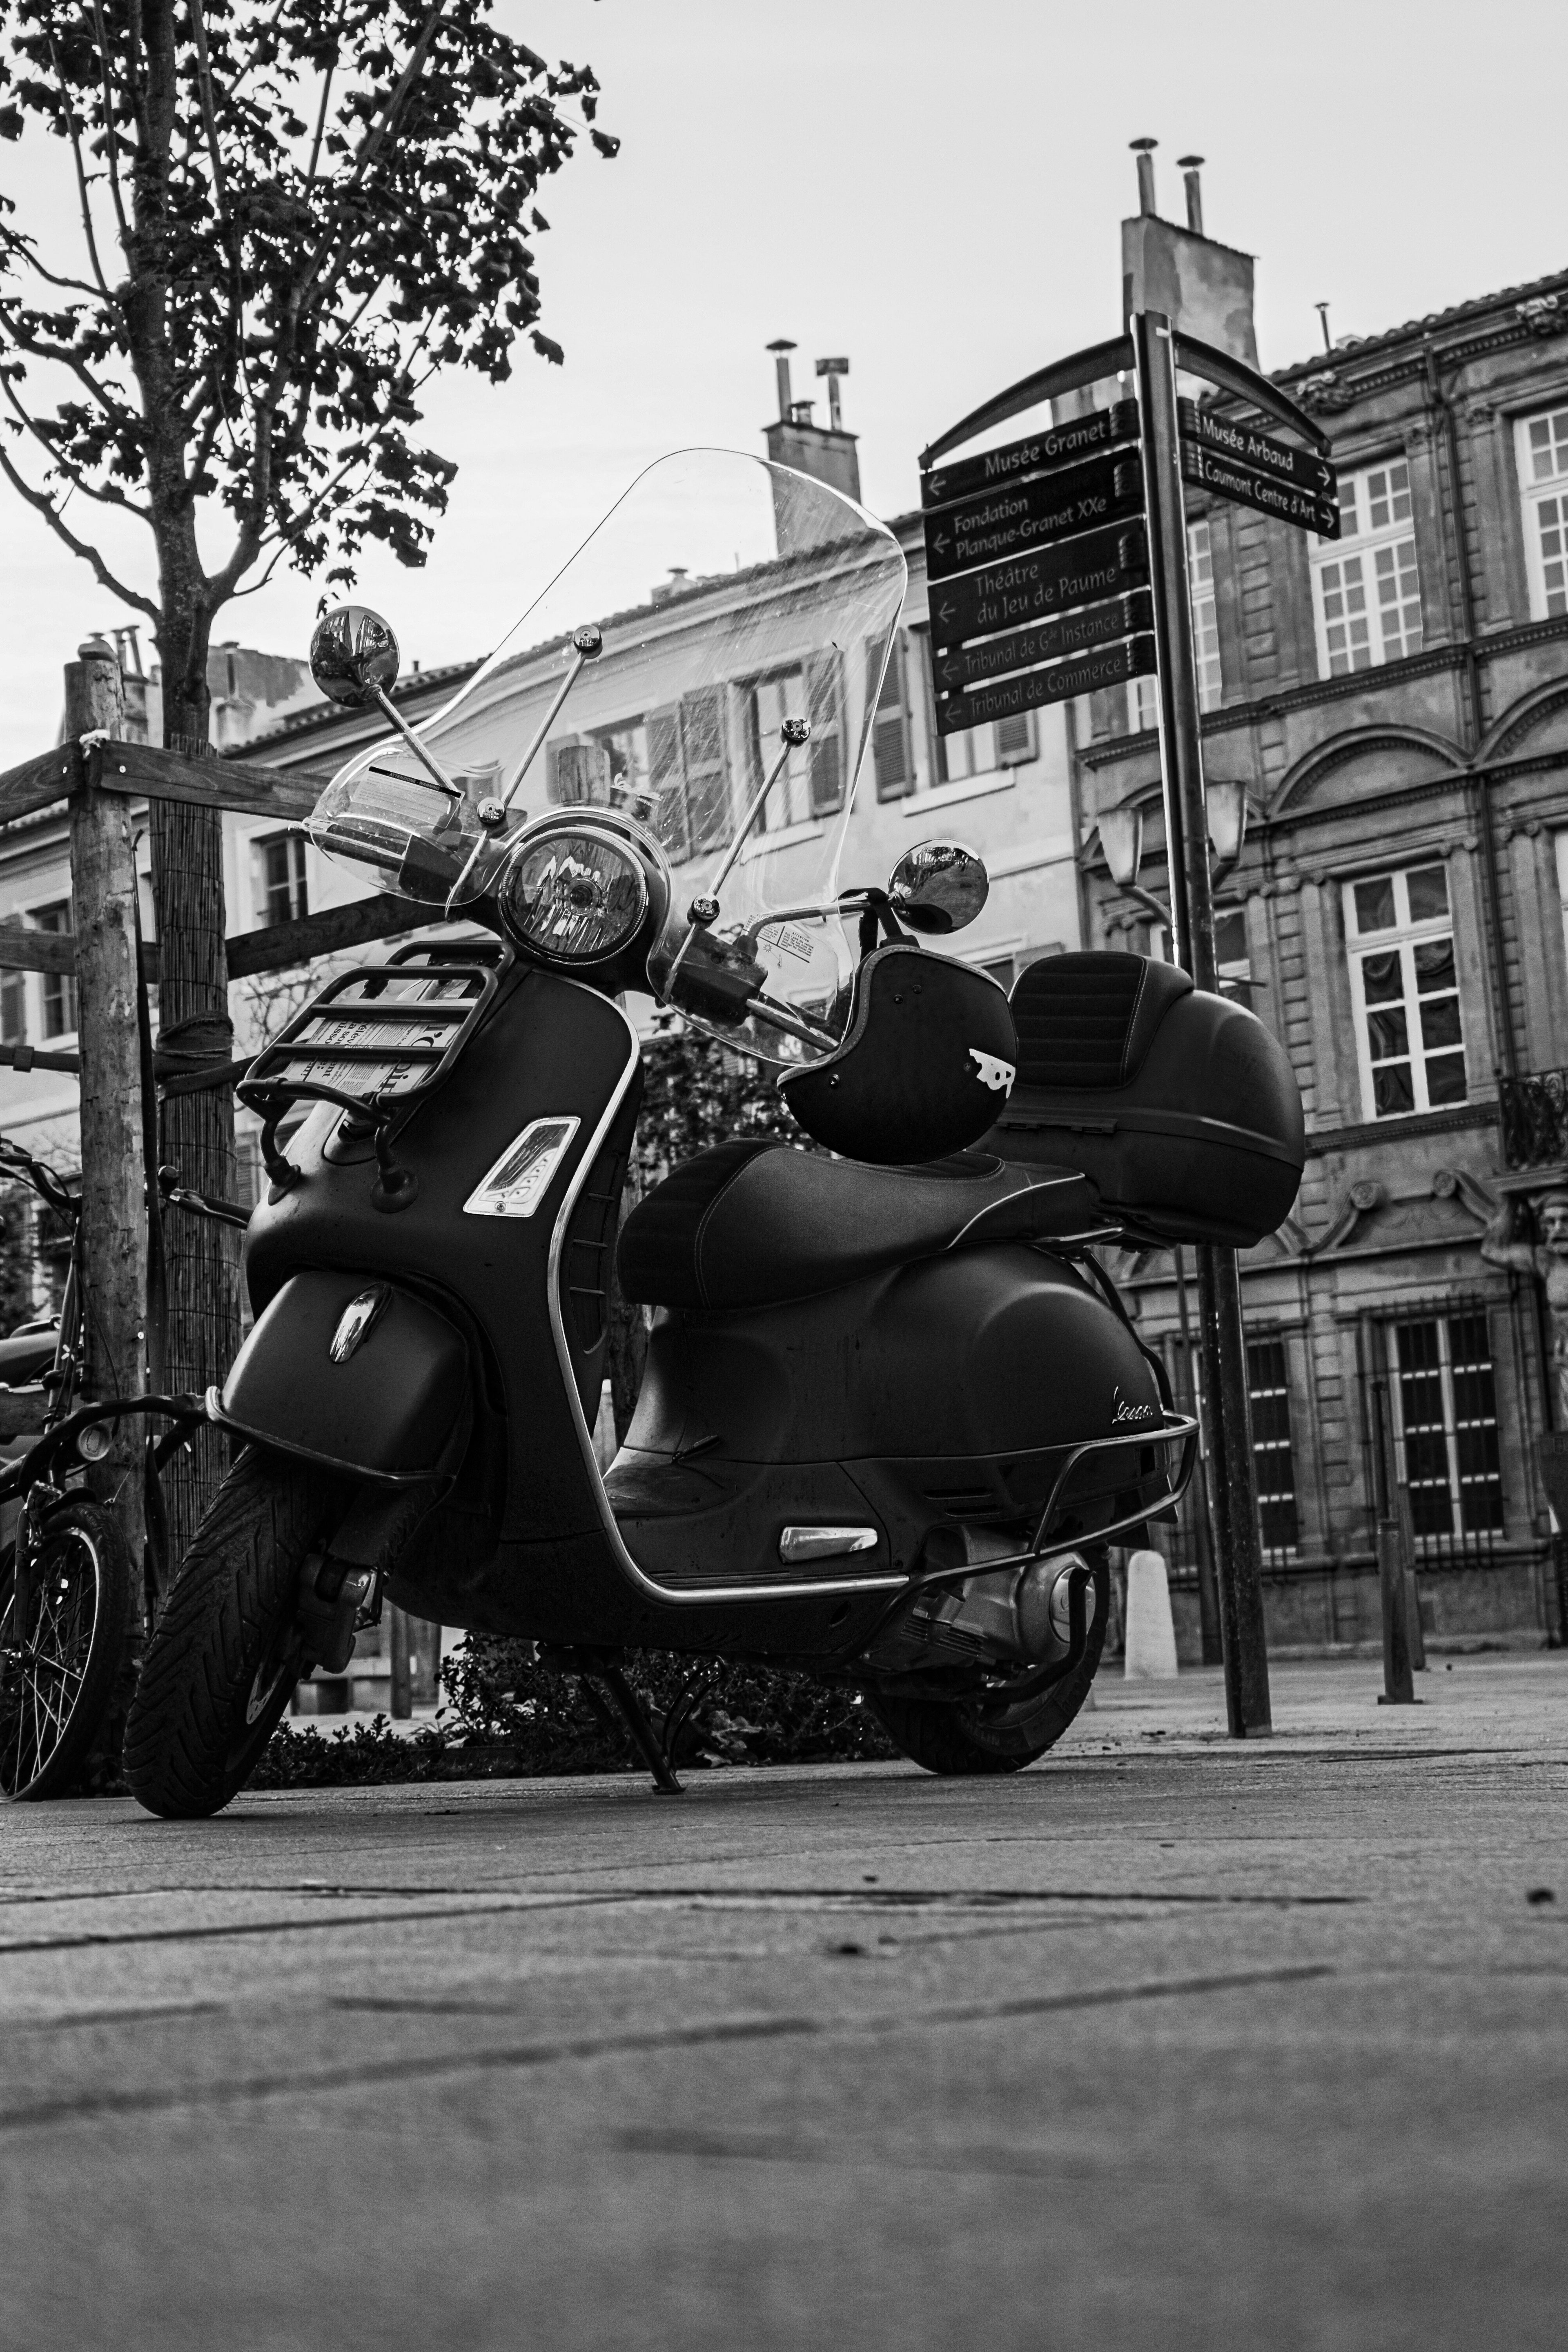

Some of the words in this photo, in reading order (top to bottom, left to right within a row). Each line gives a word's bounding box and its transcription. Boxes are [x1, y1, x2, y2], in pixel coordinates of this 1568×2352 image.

[984, 443, 1040, 477] Musée
[1045, 421, 1105, 456] Granet
[1203, 416, 1244, 451] Musée
[1247, 437, 1294, 471] Arbaud
[953, 498, 1029, 535] Fondation
[1205, 461, 1252, 497] Caumont
[1254, 481, 1288, 510] Centre
[1291, 495, 1316, 522] d'Art
[956, 507, 1074, 559] Planque-Granet
[1077, 496, 1107, 520] XXe
[975, 564, 1039, 597] Théâtre
[977, 604, 998, 624] du
[1003, 596, 1028, 618] Jeu
[1034, 584, 1054, 605] de
[1058, 567, 1116, 599] Paume
[965, 644, 1016, 675] Tribunal
[1020, 639, 1035, 657] de
[1061, 615, 1119, 645] Instance
[969, 688, 1022, 717] Tribunal
[1027, 681, 1043, 700] de
[1047, 657, 1121, 693] Commerce
[389, 772, 416, 784] ATTENZIONE
[419, 781, 441, 791] WARNING
[792, 932, 809, 942] ATTENTION
